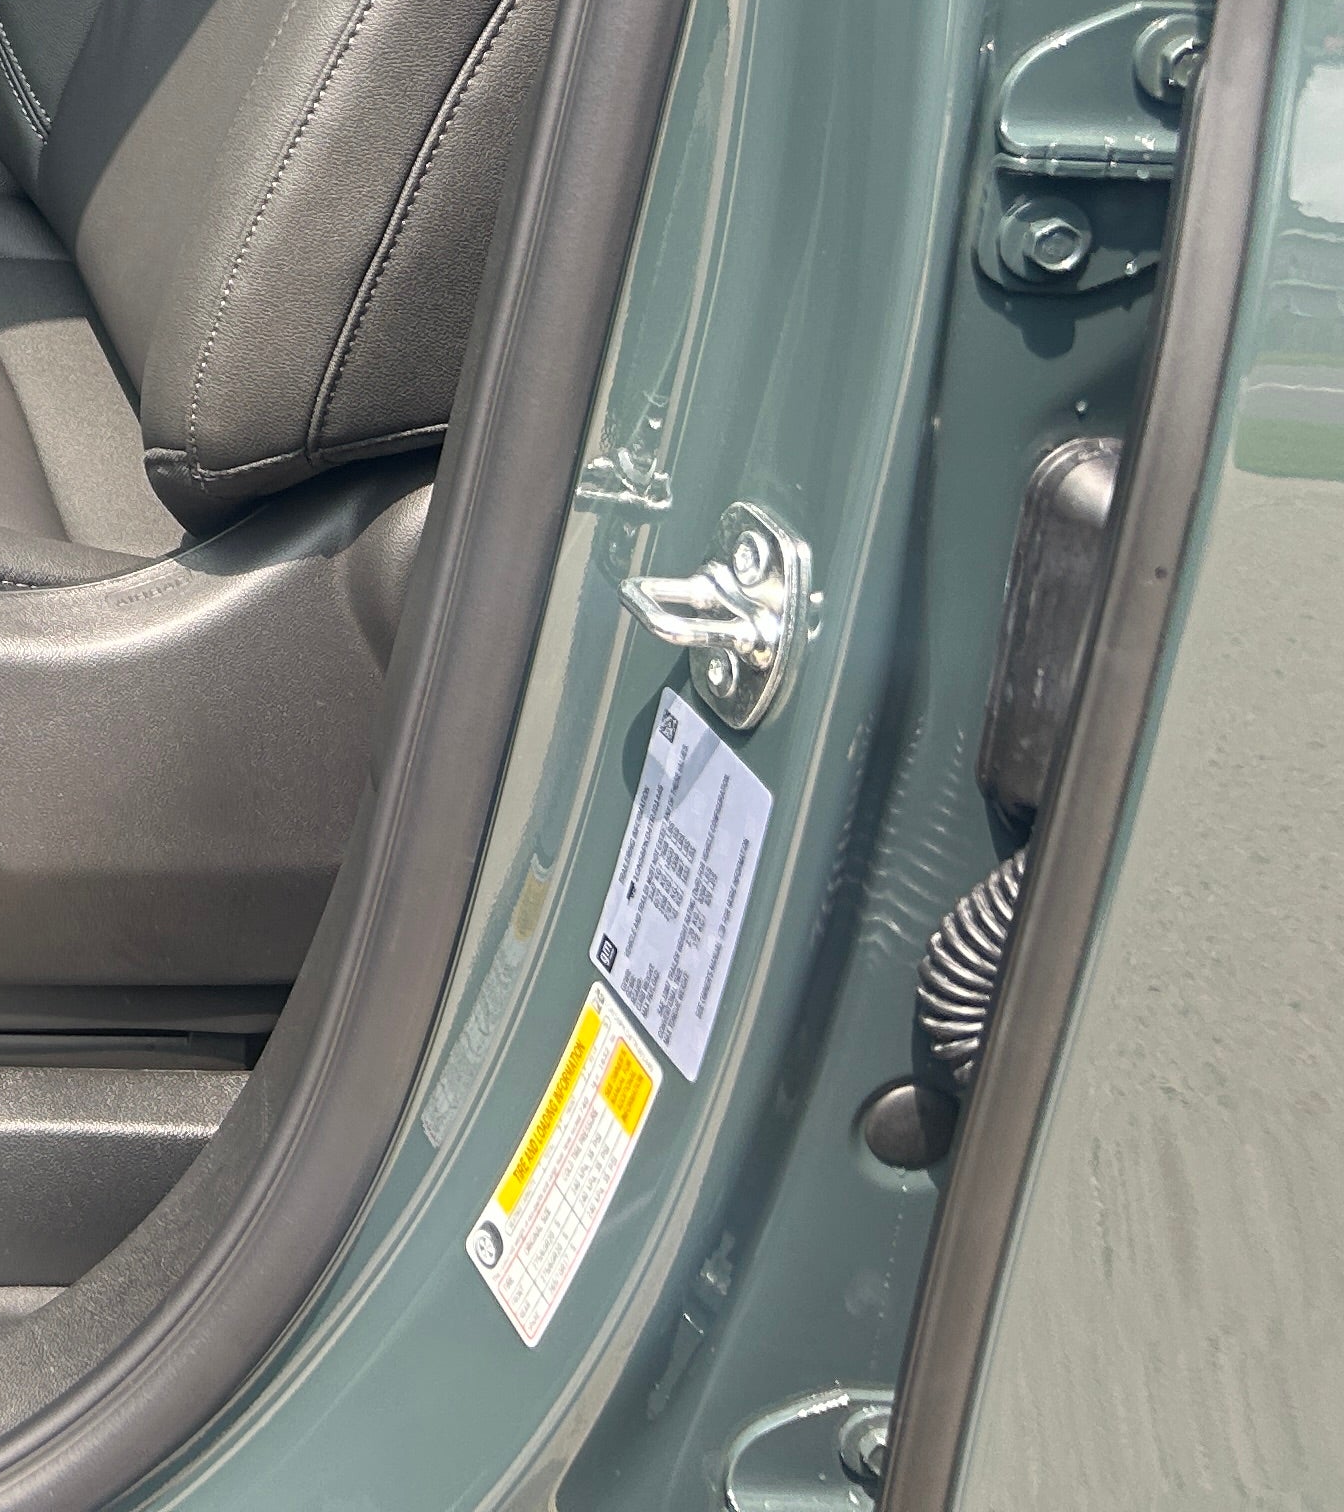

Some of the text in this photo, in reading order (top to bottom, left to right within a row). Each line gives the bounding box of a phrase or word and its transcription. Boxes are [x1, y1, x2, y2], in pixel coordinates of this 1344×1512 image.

[513, 1037, 586, 1185] TIRE AND LOADING INFORMATION
